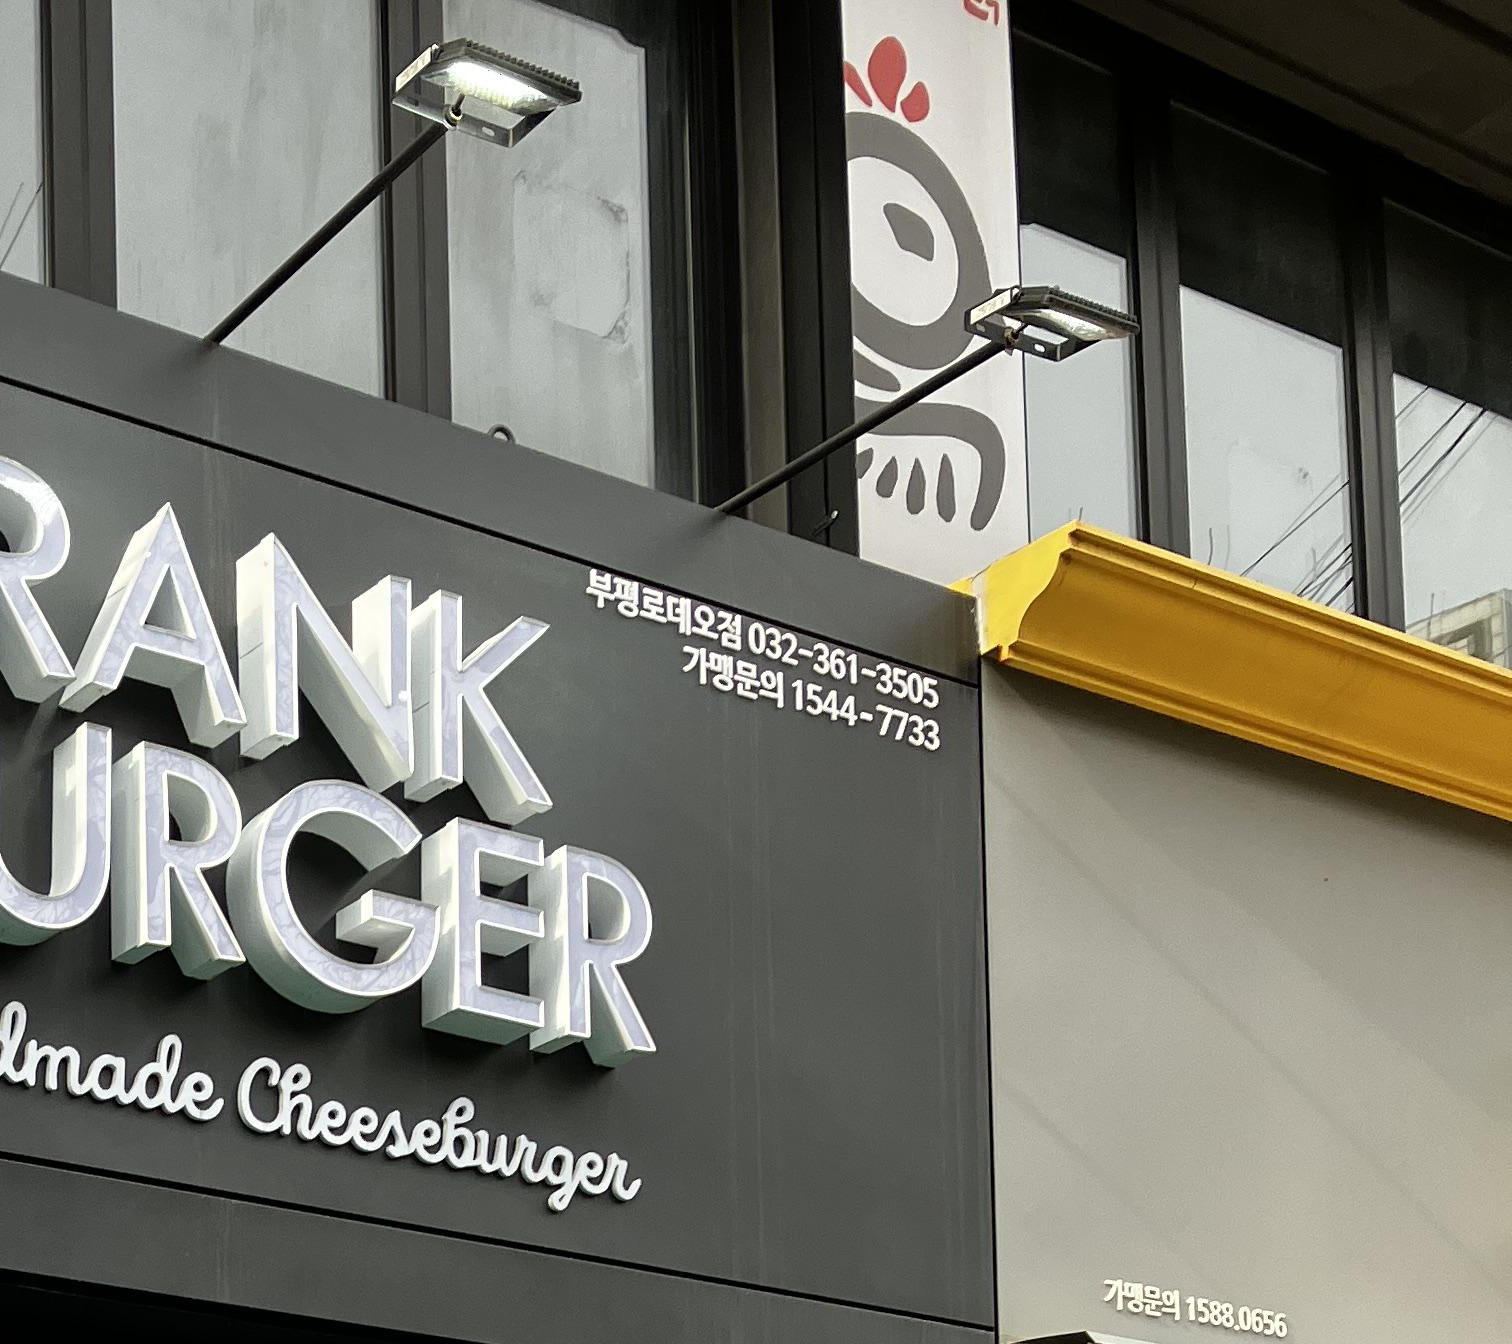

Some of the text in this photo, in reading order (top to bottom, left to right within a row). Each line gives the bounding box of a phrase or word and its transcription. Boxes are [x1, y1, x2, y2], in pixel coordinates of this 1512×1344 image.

[586, 569, 939, 709] 부평로데오점 032-361-3505
[682, 645, 940, 751] 가맹문의 1544-7733
[237, 1057, 641, 1212] Cheeseburger
[1104, 1279, 1287, 1338] 가맹문의 1588.0656
